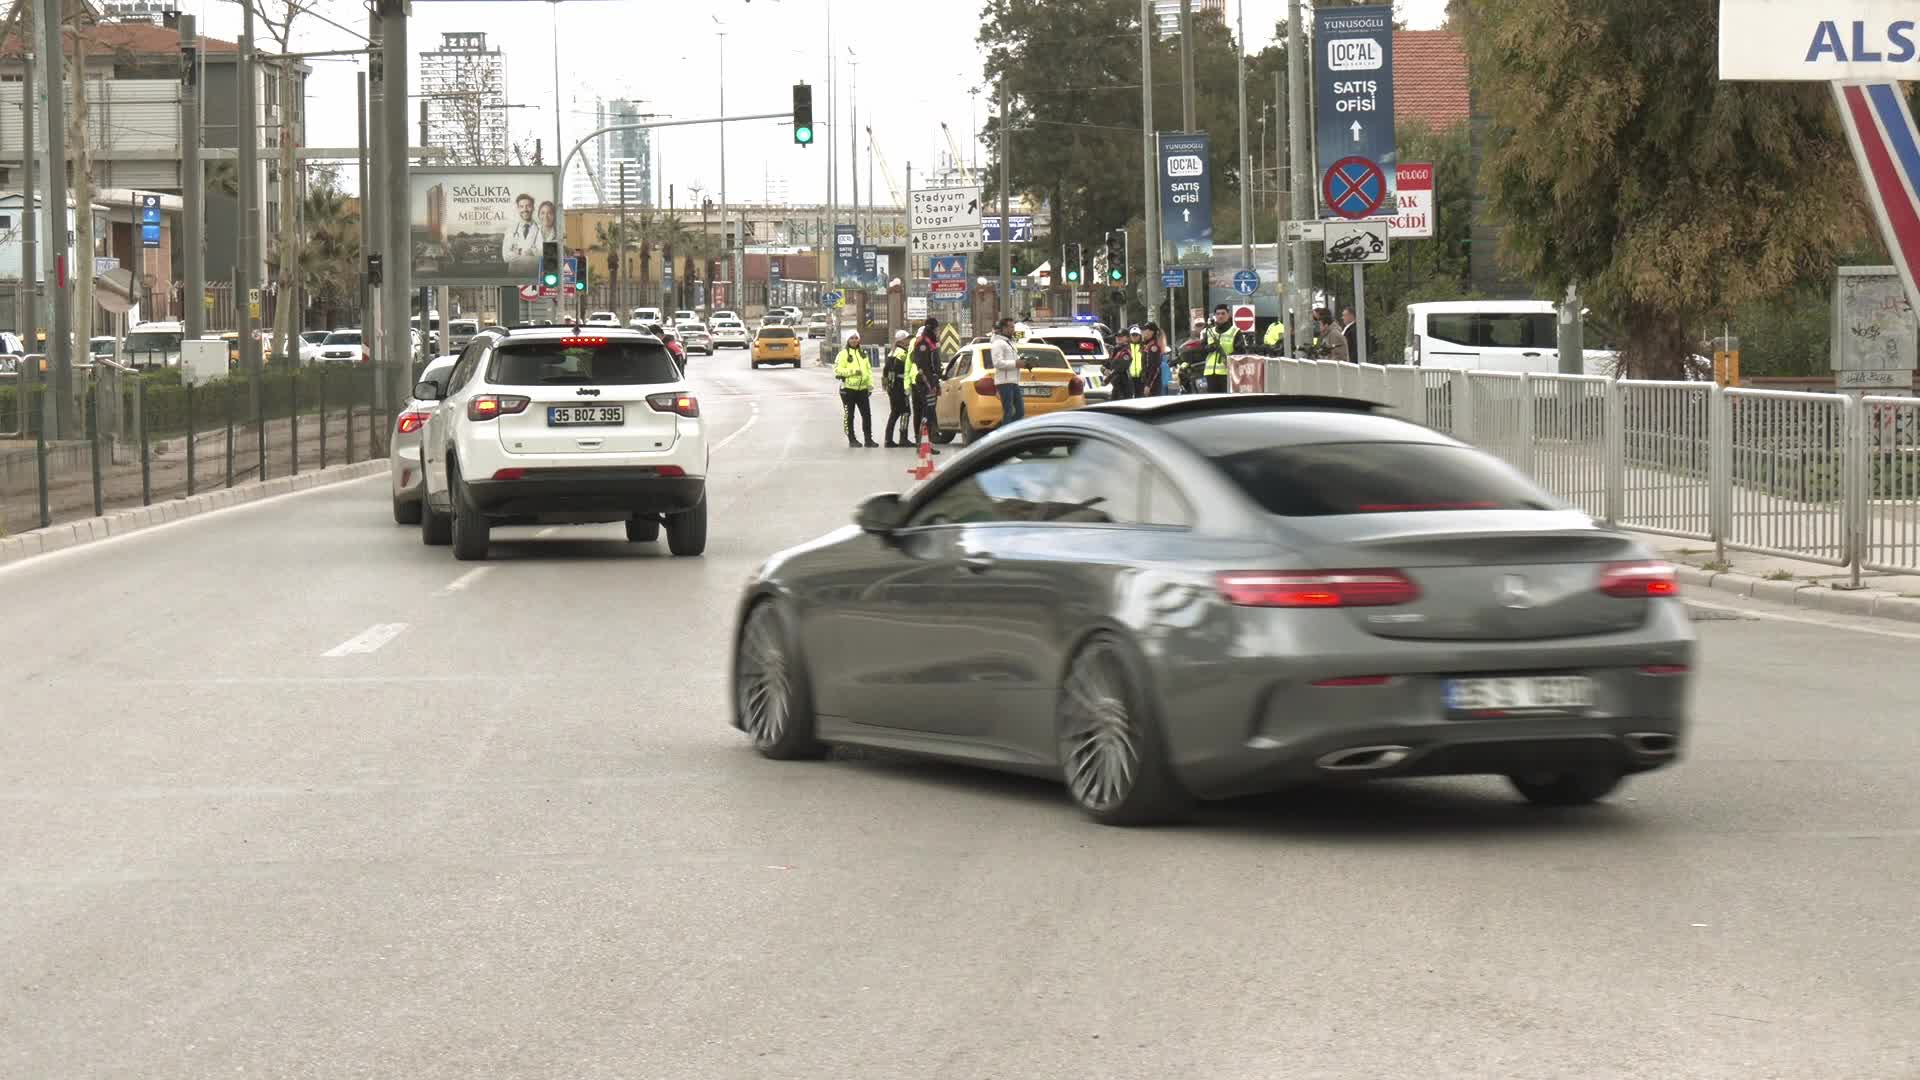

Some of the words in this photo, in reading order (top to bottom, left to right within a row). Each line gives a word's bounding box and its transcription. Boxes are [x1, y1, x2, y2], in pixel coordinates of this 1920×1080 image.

[1324, 18, 1384, 29] YUNUSOĞLU
[1804, 20, 1920, 63] ALS
[1332, 43, 1375, 66] LOC'AL
[1333, 80, 1377, 95] SATIŞ
[1335, 95, 1376, 112] OFİSİ
[453, 184, 511, 196] SAĞLIKTA
[1171, 182, 1200, 192] SATIŞ
[914, 192, 965, 203] Stadyum
[1172, 193, 1199, 203] OFİSİ
[926, 203, 964, 213] Sanayi
[915, 216, 953, 226] Otogar
[1388, 213, 1426, 229] SCİDİ
[922, 232, 975, 241] Bornova
[922, 240, 979, 250] Karşıyaka
[576, 387, 601, 397] Jeep
[555, 409, 569, 421] 35
[574, 408, 595, 421] BOZ
[599, 408, 621, 421] 395
